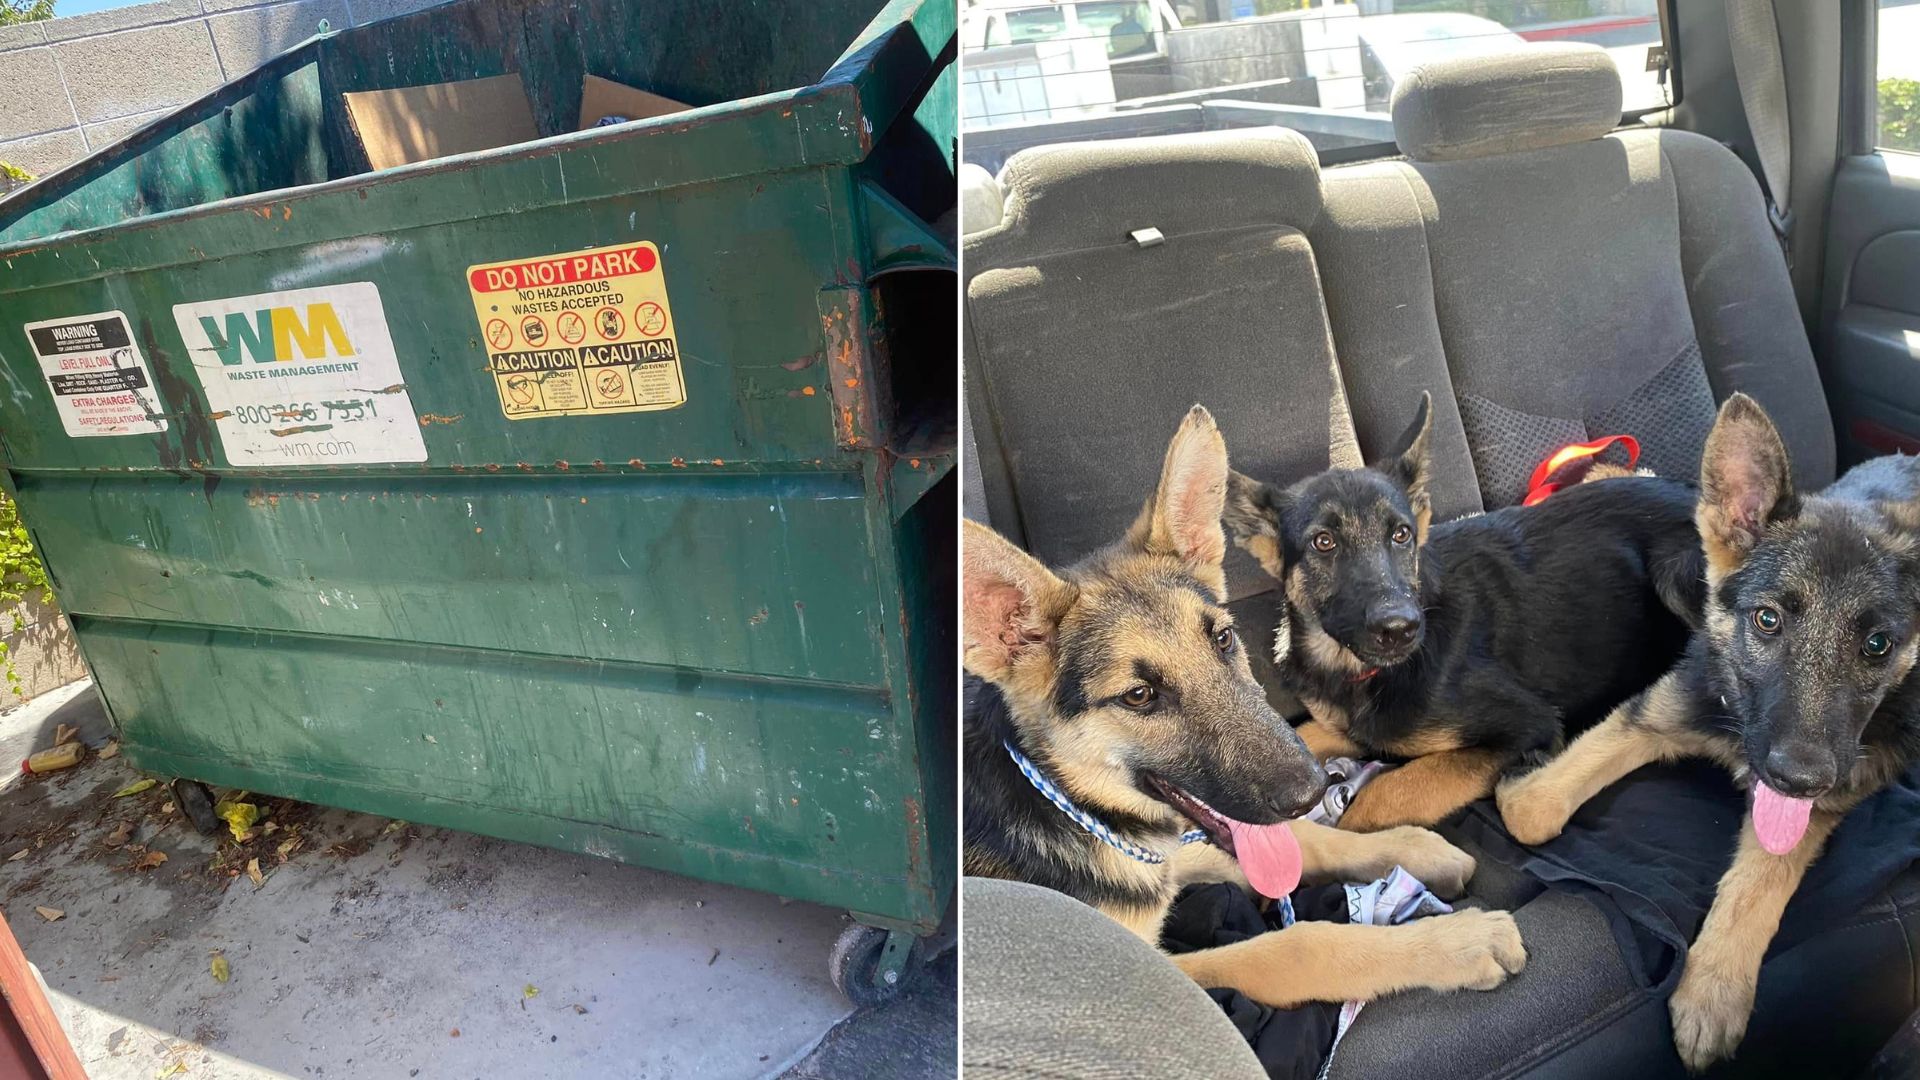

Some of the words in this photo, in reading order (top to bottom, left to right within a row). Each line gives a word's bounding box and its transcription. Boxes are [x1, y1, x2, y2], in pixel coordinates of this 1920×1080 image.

[485, 268, 518, 291] DO
[521, 260, 567, 286] NOT
[573, 249, 643, 280] PARK
[518, 290, 535, 302] NO
[538, 280, 610, 299] HAZARDOUS
[512, 301, 558, 316] WASTES
[561, 293, 624, 311] ACCEPTED
[51, 324, 98, 341] WARNING
[198, 302, 356, 366] WM
[508, 349, 576, 371] CAUTION
[597, 340, 674, 364] CAUTION
[59, 360, 79, 370] LEVEL
[80, 357, 96, 369] FULL
[96, 355, 114, 367] ONL
[227, 370, 267, 381] WASTE
[269, 362, 359, 378] MANAGEMENT
[71, 397, 96, 408] EXTRA
[96, 394, 136, 407] CHARGES
[78, 416, 99, 426] SAFETY
[100, 413, 145, 425] REGULATIONS
[235, 405, 272, 424] 800
[279, 440, 357, 457] wm.com
